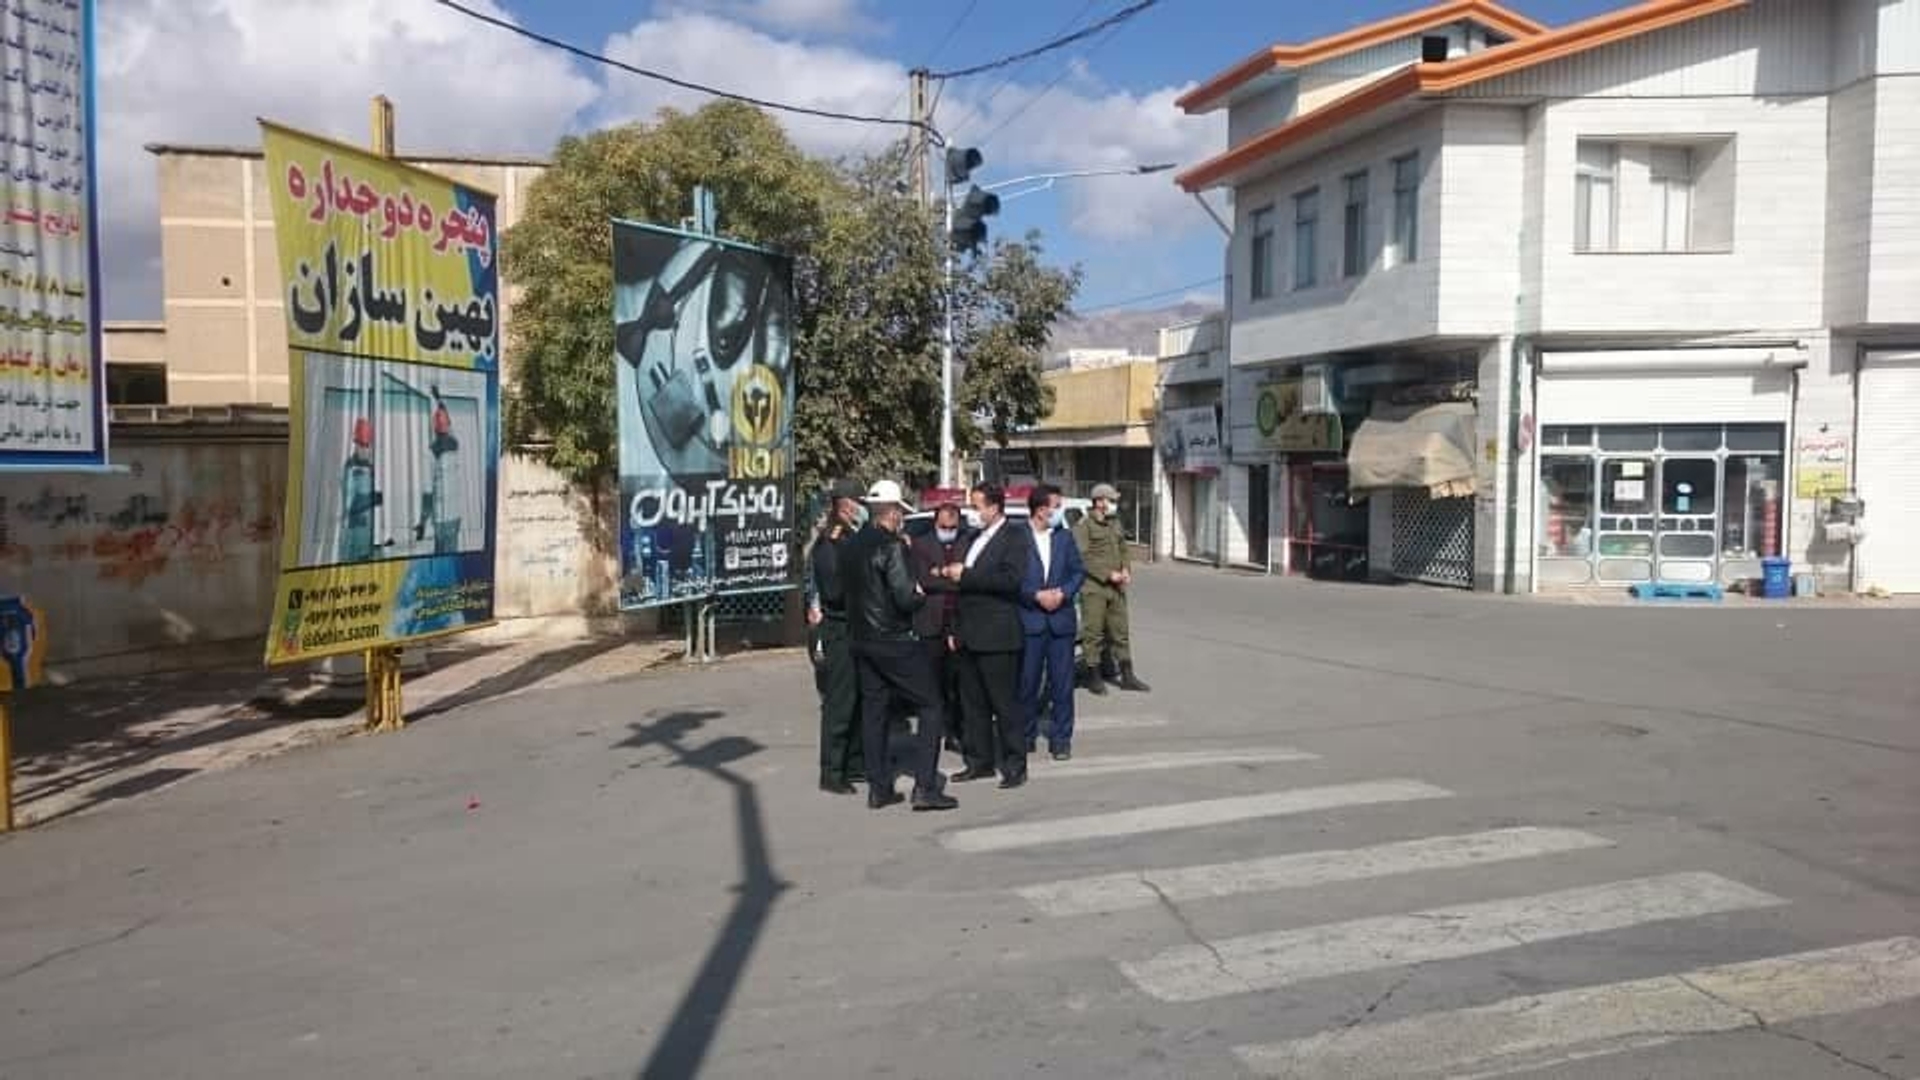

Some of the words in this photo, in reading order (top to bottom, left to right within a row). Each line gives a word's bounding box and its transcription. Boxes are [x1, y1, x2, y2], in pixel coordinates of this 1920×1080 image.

[418, 203, 491, 268] پنجره
[291, 240, 407, 342] سازان
[414, 288, 495, 362] بهین
